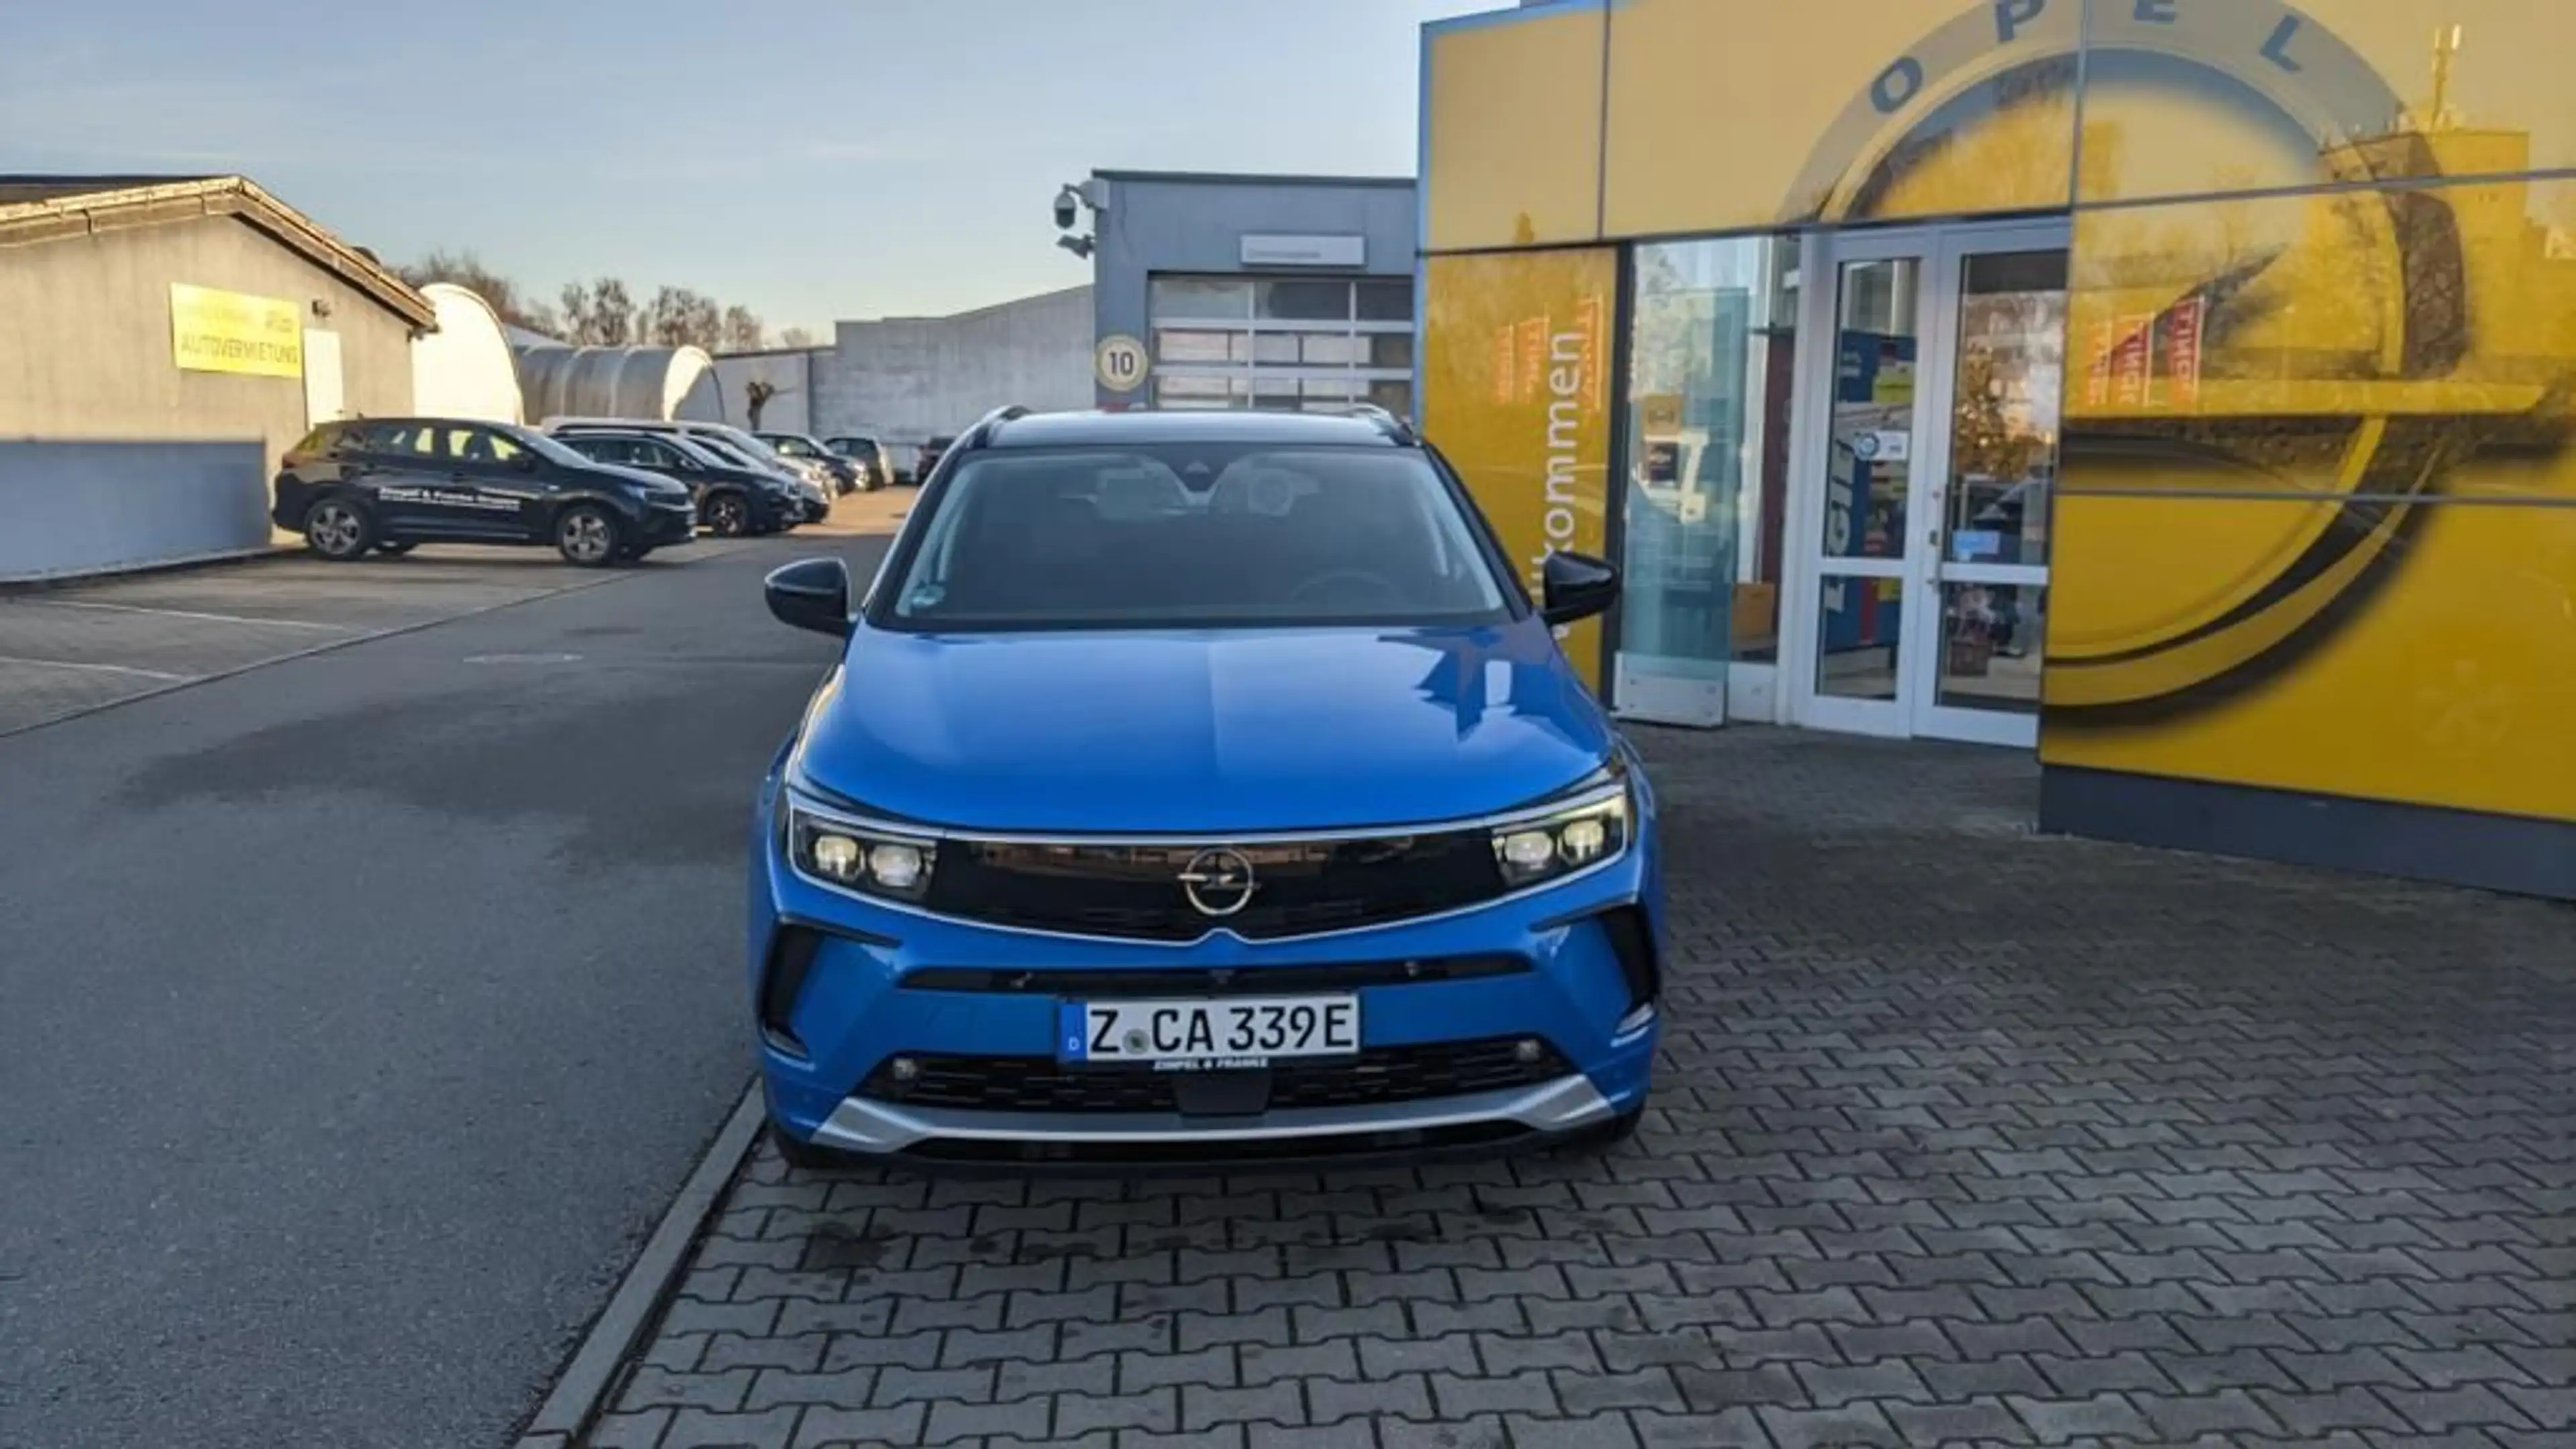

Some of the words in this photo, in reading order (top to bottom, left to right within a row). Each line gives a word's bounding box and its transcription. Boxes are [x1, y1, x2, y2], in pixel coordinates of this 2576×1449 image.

[1109, 351, 1134, 375] 10
[1090, 1009, 1120, 1053] Z
[1152, 1008, 1214, 1052] CA
[1228, 1005, 1353, 1051] 339E
[1068, 1038, 1079, 1051] D
